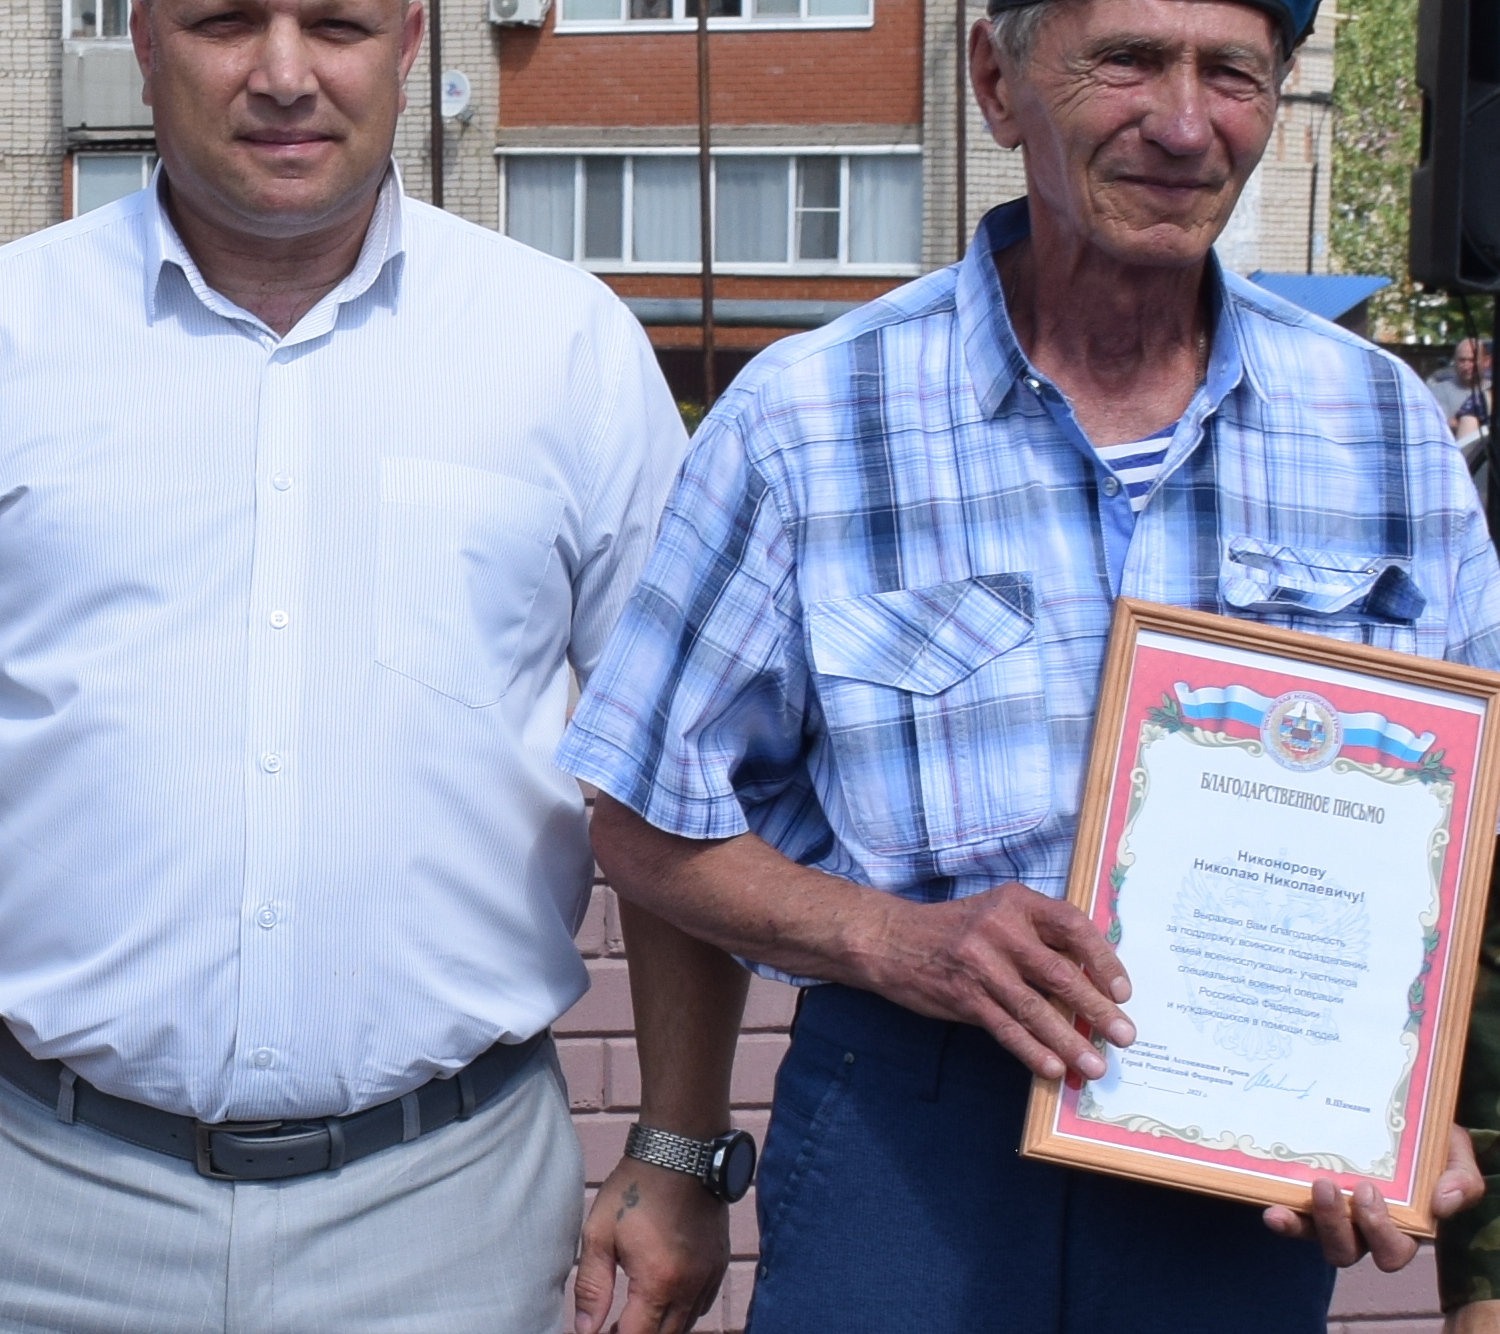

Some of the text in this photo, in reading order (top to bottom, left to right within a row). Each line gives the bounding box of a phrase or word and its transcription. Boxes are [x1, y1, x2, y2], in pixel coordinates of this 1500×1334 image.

[1200, 771, 1385, 825] БЛАГОДАРСТВЕННОЕ ПИСЬМО
[1193, 857, 1365, 904] Николаю Николаевичу!
[1237, 849, 1327, 881] Никонорову
[1166, 924, 1178, 933] за
[1180, 927, 1236, 946] поддержку
[1238, 939, 1285, 955] воинских
[1193, 908, 1346, 948] Выражаю Вам благодарность
[1177, 965, 1344, 1004] специальной военной операции
[1300, 970, 1358, 988] участников
[1177, 1003, 1250, 1024] нуждающихся
[1261, 1020, 1302, 1034] помощи
[1199, 987, 1321, 1018] Российской Федерации
